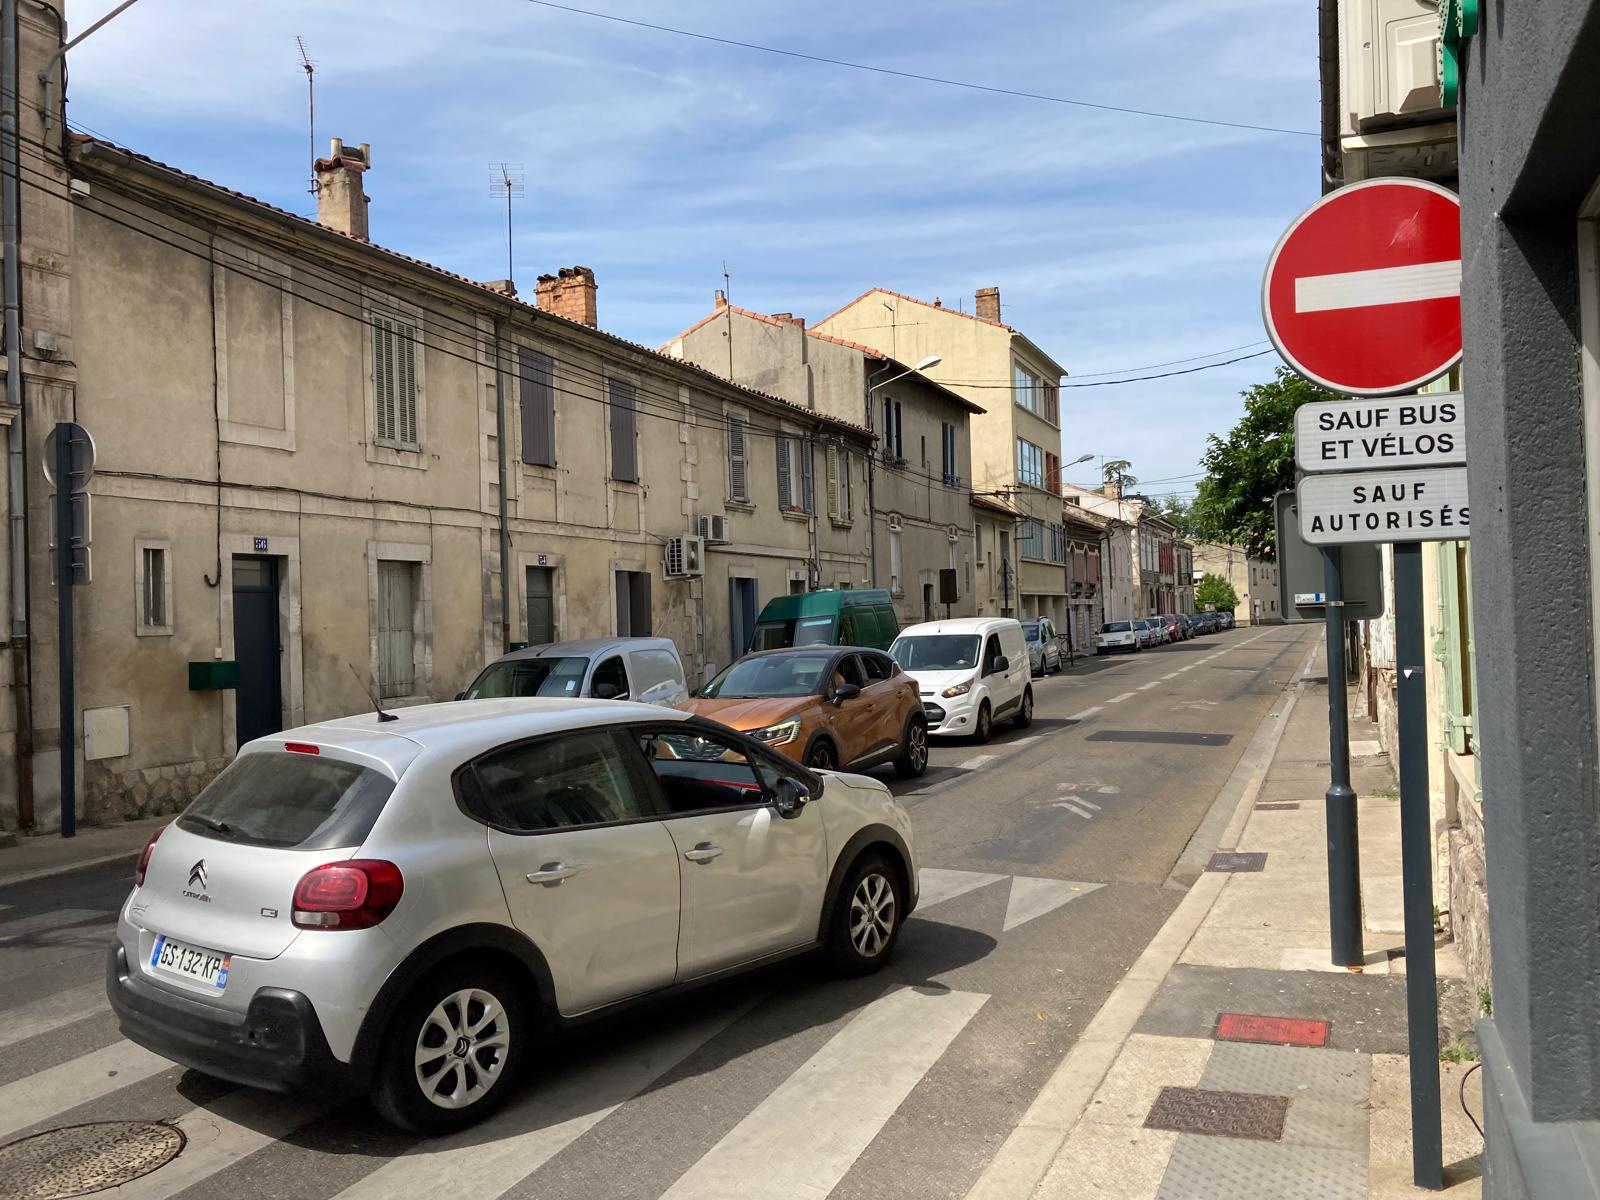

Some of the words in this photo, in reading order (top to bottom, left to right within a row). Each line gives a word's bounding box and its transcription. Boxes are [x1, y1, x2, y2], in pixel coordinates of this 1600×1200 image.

[1318, 408, 1389, 431] SAUF
[1399, 403, 1457, 426] BUS
[1321, 439, 1354, 460] ET
[1361, 432, 1454, 458] VÉLOS
[1352, 482, 1426, 504] SAUF
[1311, 504, 1470, 533] AUTORISÉS
[255, 539, 267, 549] 56
